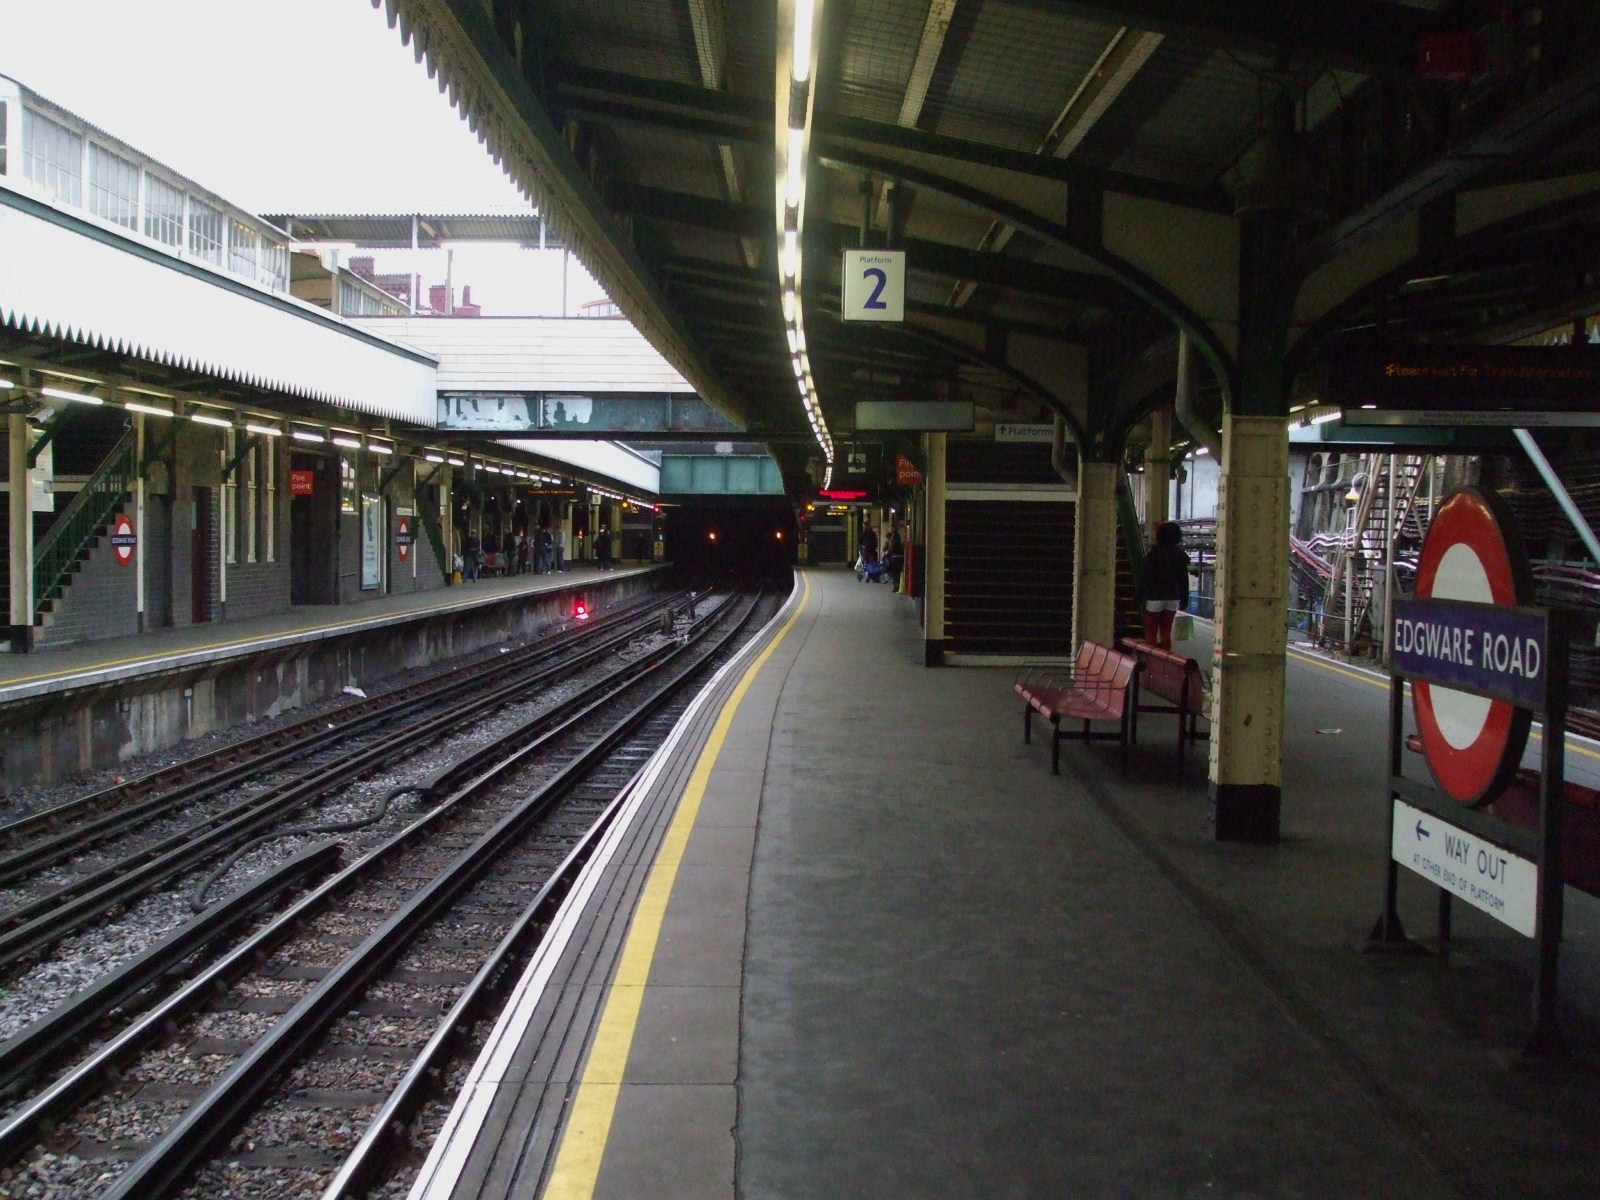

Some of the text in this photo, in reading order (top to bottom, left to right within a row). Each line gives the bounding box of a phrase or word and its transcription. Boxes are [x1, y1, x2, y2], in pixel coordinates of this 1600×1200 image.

[859, 256, 892, 264] Platform
[863, 267, 887, 310] 2
[1008, 426, 1054, 436] Platforms
[292, 482, 311, 490] point
[1394, 618, 1541, 679] EDGWARE ROAD
[1444, 832, 1508, 885] WAY OUT
[1413, 853, 1504, 911] AT OTHER END OF PLATFORM
